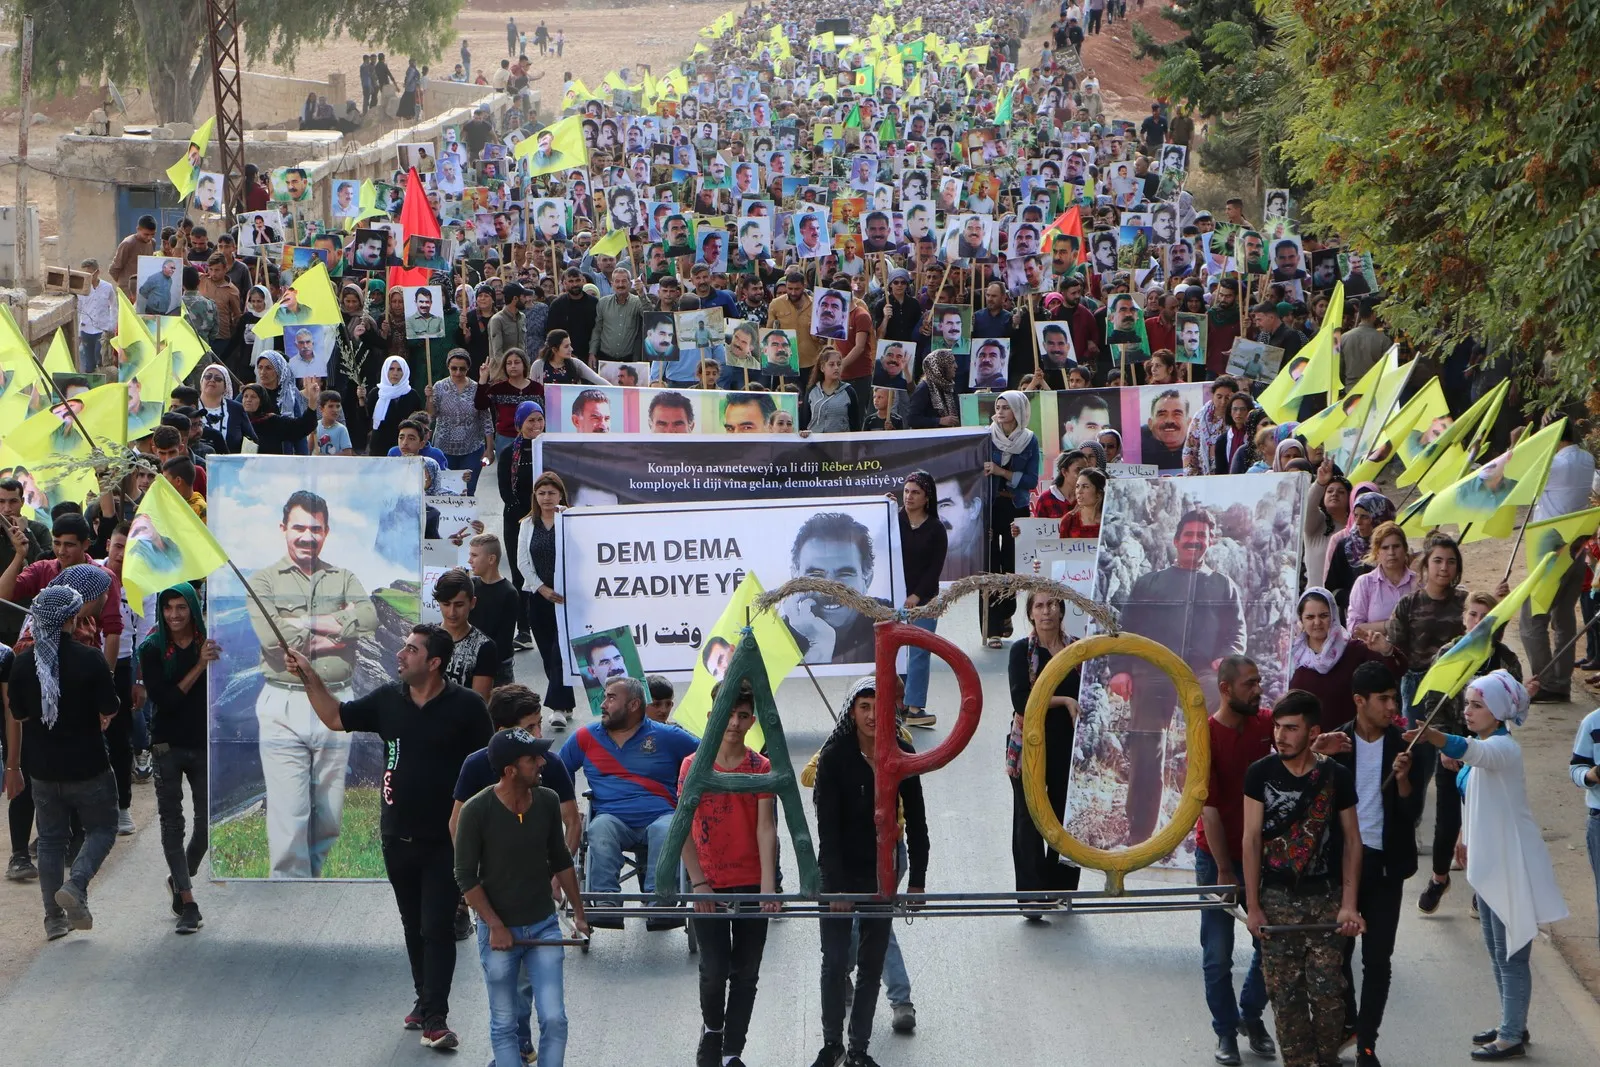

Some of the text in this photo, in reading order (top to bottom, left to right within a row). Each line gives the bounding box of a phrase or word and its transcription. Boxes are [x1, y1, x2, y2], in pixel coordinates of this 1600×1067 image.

[648, 460, 883, 476] Komploya navneteweyî ya li dijî Rêber APO,
[629, 474, 904, 492] komployek li dijî vîna gelan, demokrasî û aşitiyê ye
[597, 537, 742, 564] DEM DEMA
[594, 573, 711, 597] AZADIYE
[654, 622, 703, 649] وقت
[655, 620, 1211, 898] APO
